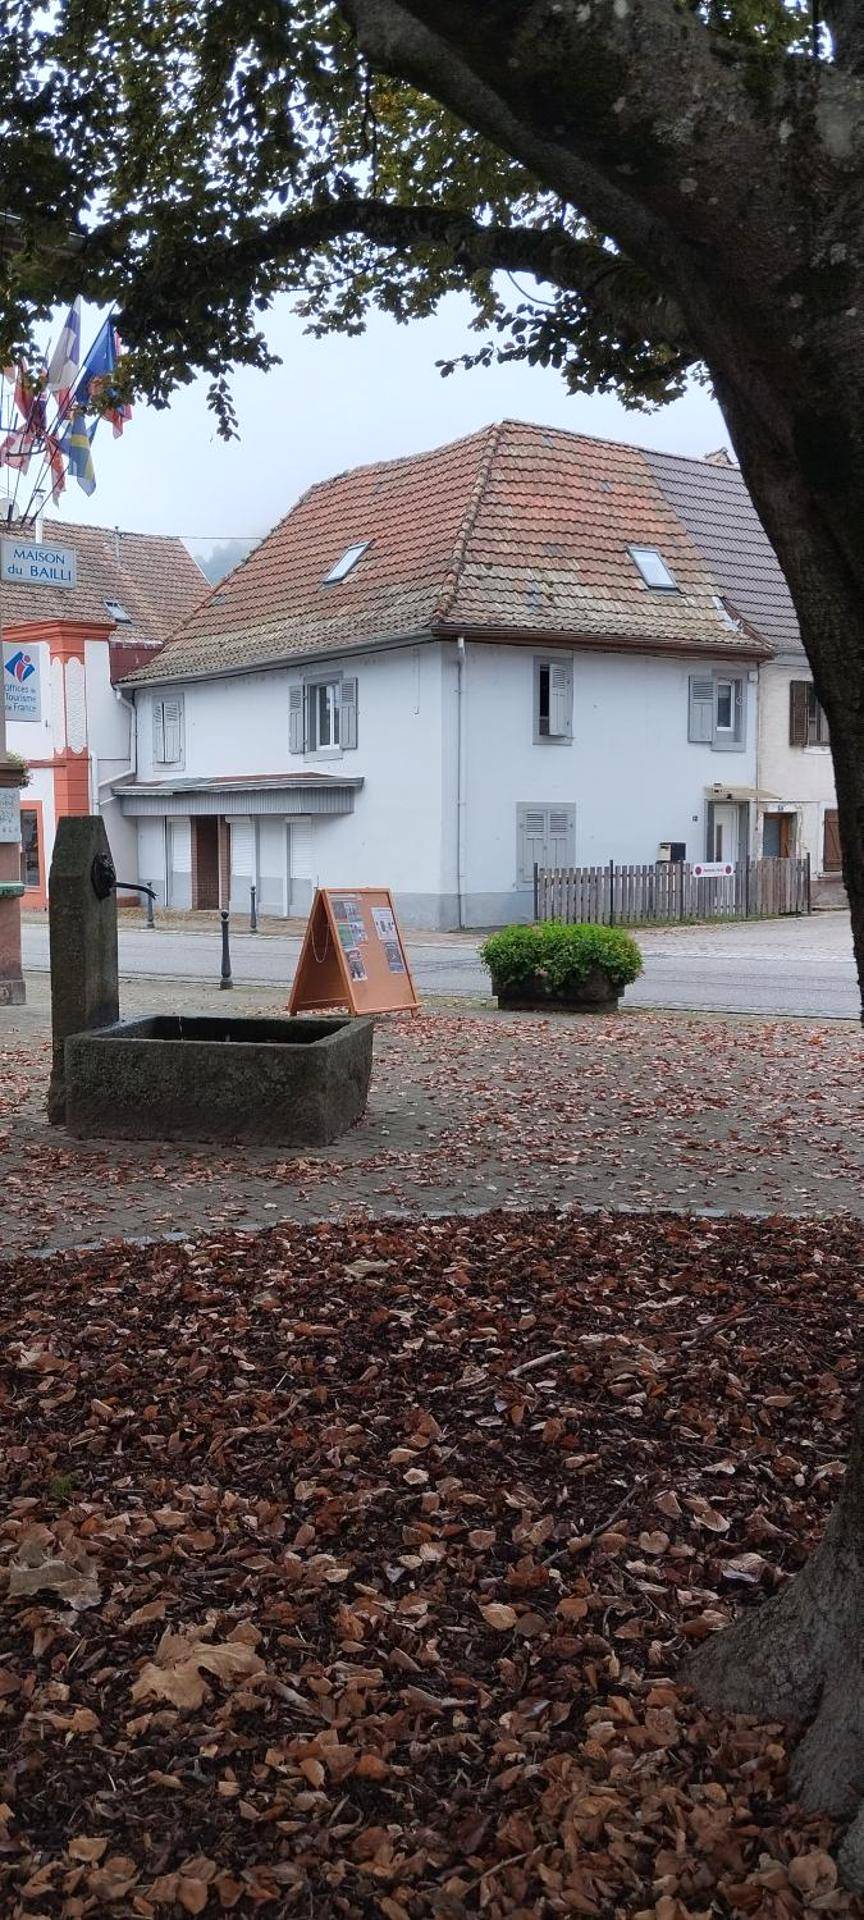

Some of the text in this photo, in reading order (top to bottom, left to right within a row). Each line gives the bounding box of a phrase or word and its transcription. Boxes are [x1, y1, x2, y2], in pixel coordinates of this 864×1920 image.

[13, 549, 65, 565] MAISON
[7, 563, 71, 582] du BAILLI
